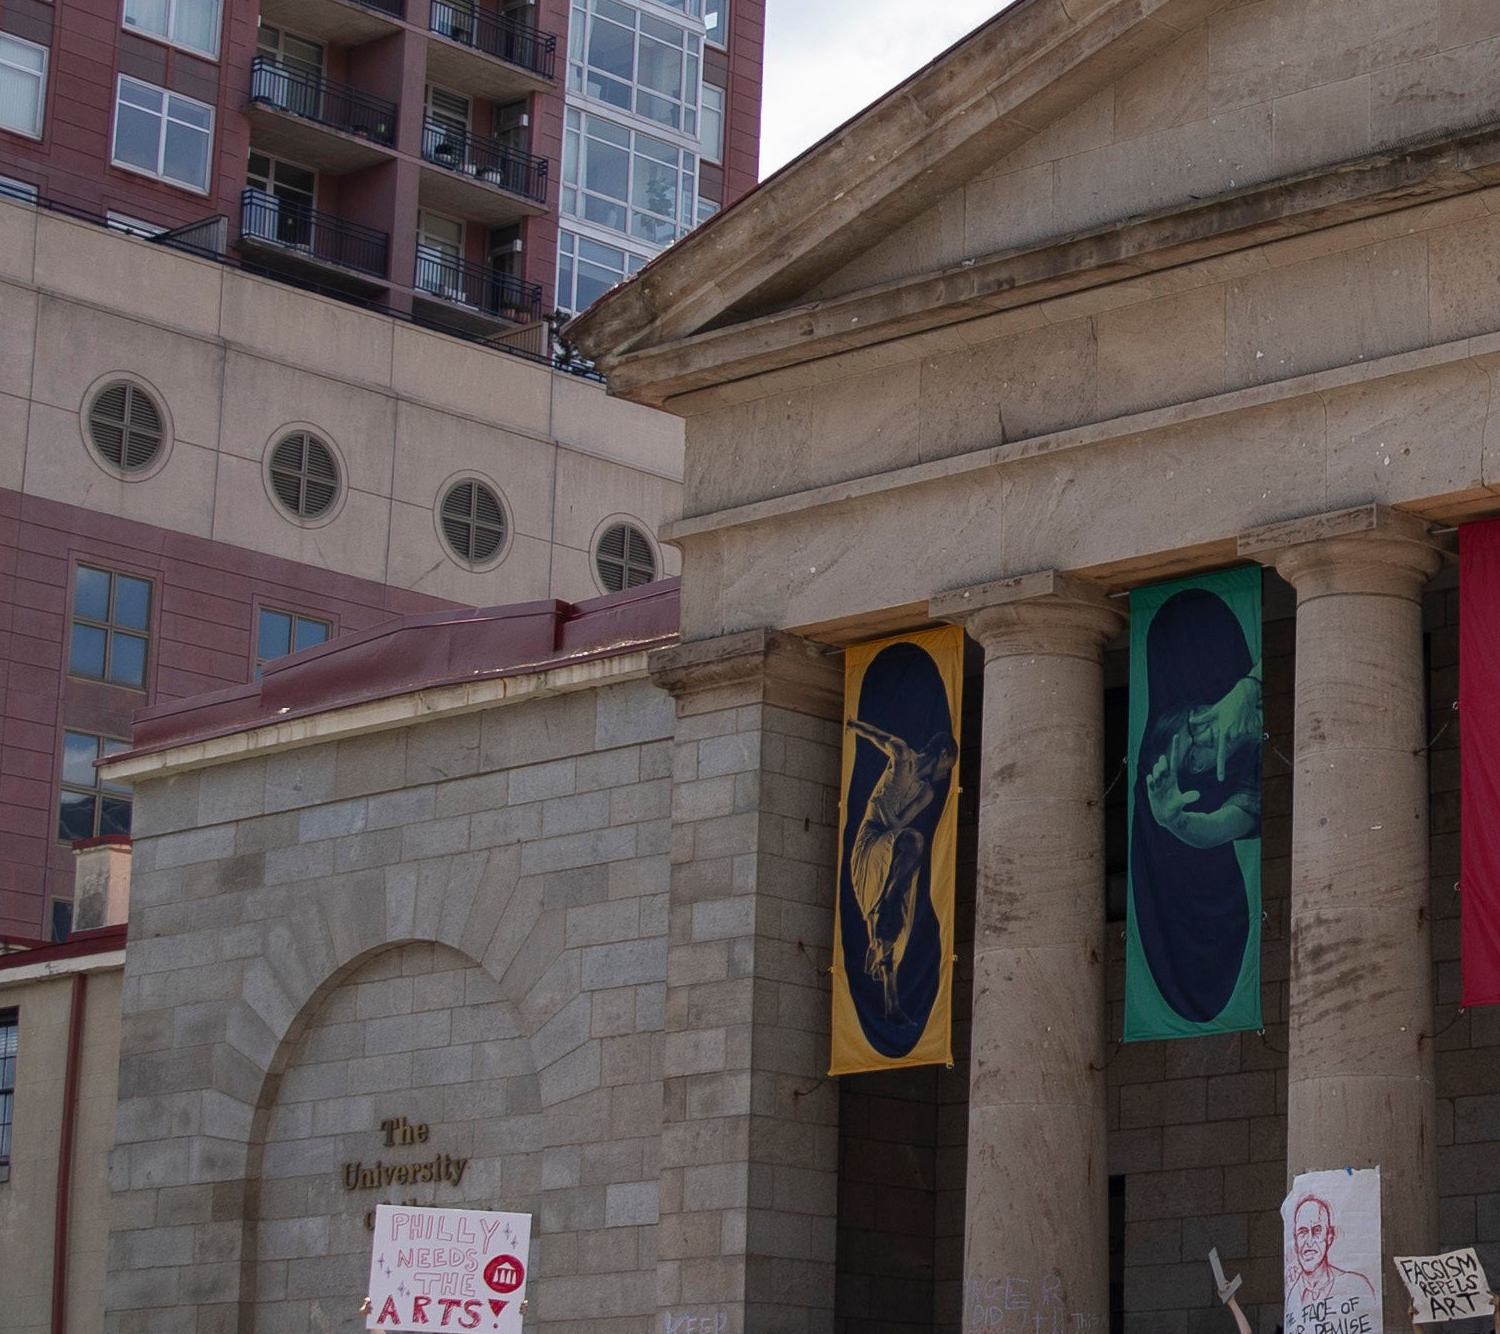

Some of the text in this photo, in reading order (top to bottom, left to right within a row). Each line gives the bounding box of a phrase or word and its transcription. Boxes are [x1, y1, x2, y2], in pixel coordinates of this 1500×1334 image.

[381, 1117, 430, 1147] The
[341, 1153, 469, 1191] University
[391, 1213, 500, 1255] PHILLY
[397, 1248, 479, 1272] NEEDS
[1400, 1253, 1478, 1285] FACSISM
[413, 1272, 476, 1297] THE
[1419, 1274, 1479, 1299] REPELS
[376, 1294, 509, 1329] ARTS!
[1301, 1296, 1361, 1325] FACE OF
[1430, 1291, 1480, 1321] ART
